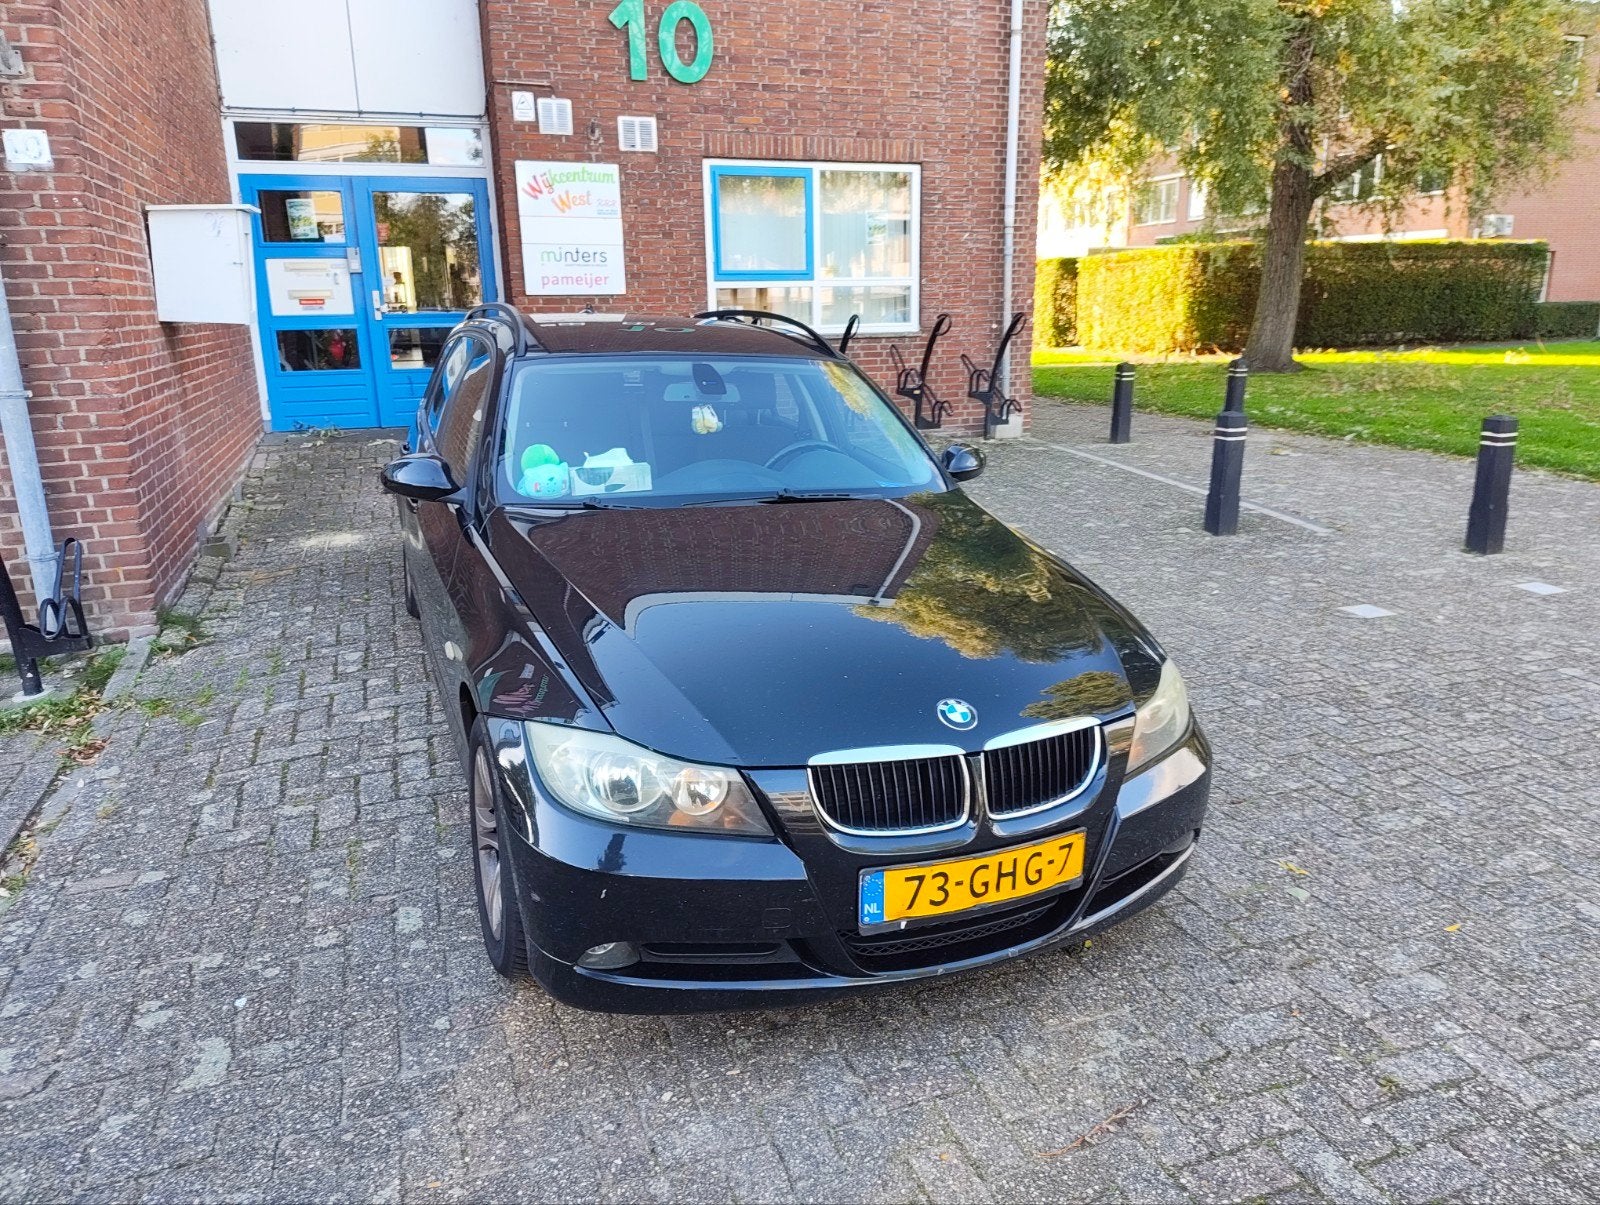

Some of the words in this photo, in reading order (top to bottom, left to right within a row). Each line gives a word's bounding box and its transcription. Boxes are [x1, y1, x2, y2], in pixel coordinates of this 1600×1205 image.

[607, 0, 714, 84] 10
[522, 166, 616, 200] Wijkcentrum
[551, 190, 592, 213] West
[541, 273, 610, 289] pameijer
[903, 842, 1074, 911] 73-GHG-7
[863, 902, 882, 915] NL
